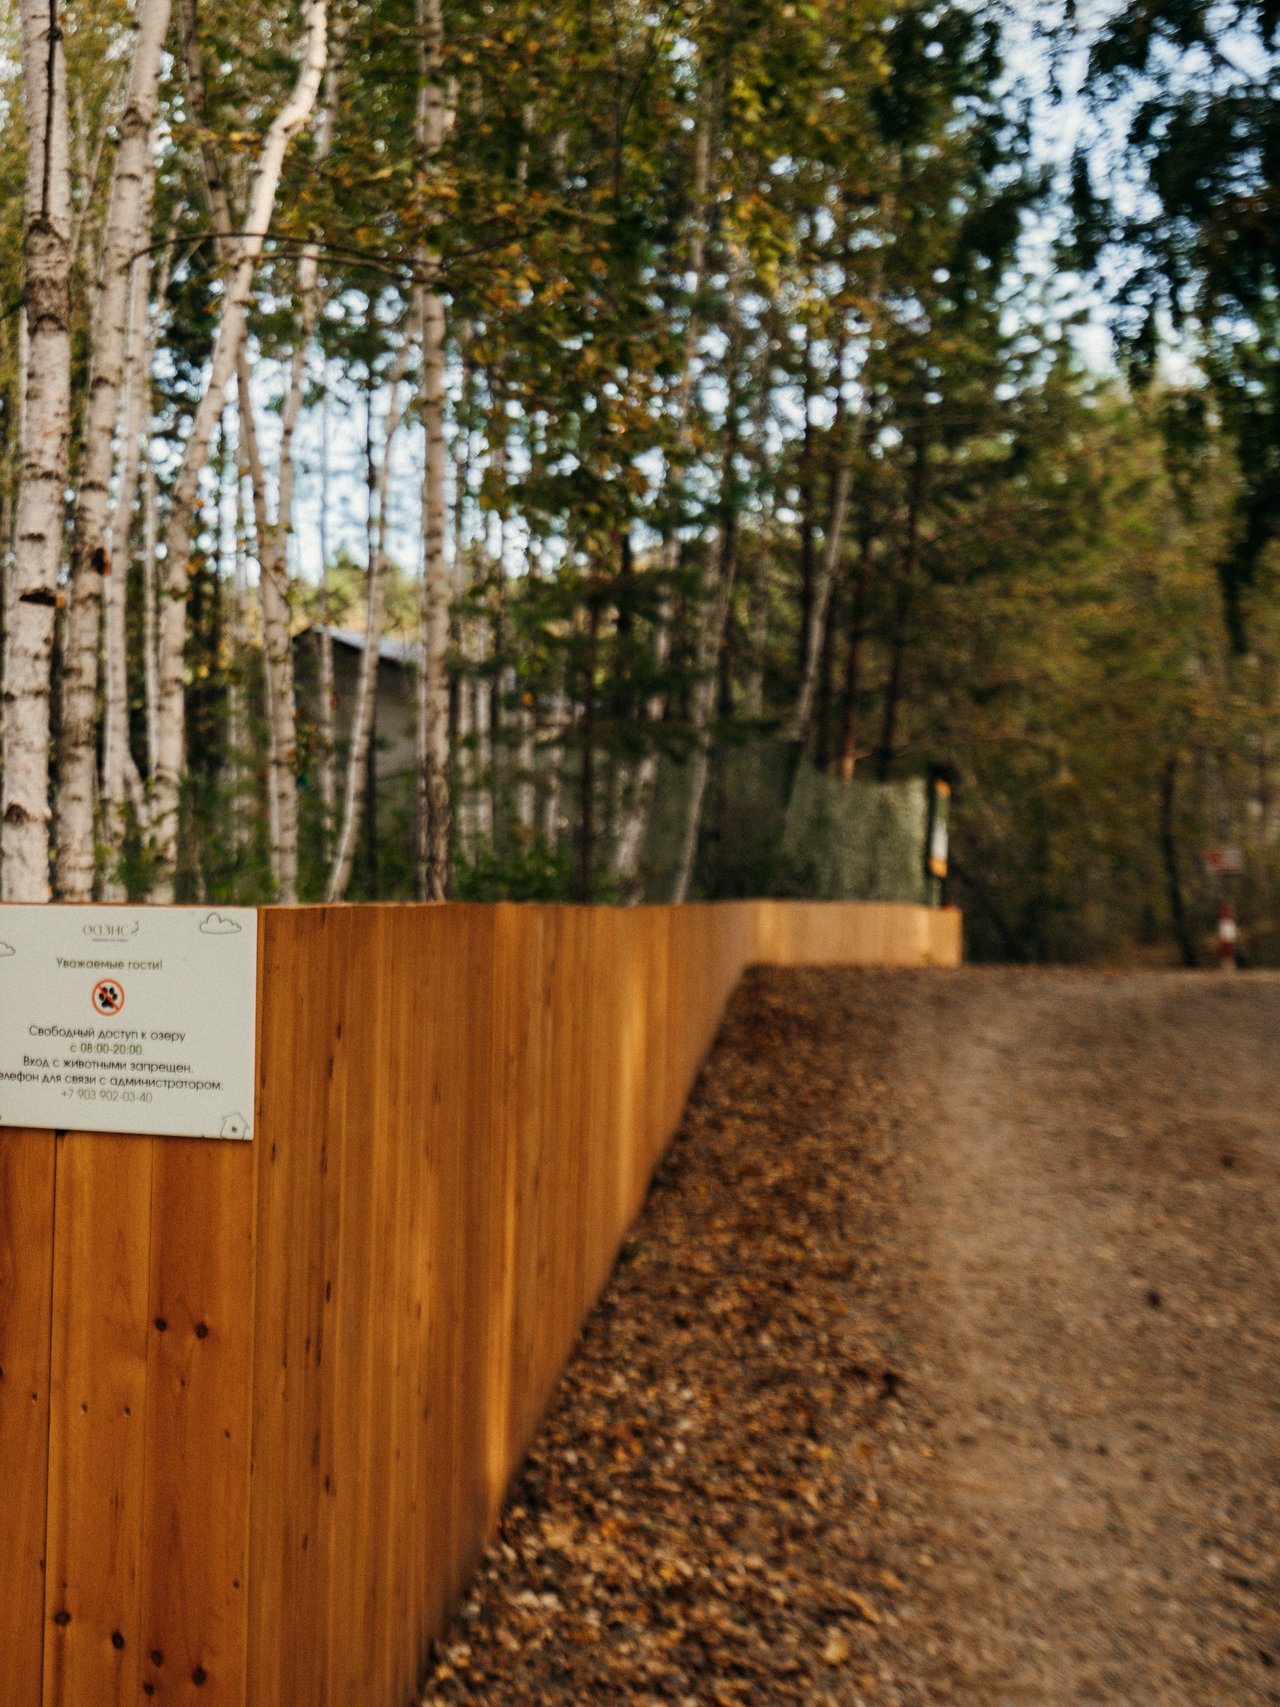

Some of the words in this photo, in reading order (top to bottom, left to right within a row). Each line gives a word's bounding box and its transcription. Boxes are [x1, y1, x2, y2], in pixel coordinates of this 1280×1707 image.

[56, 957, 125, 972] Уважаемые
[127, 959, 163, 972] гости!
[29, 1025, 95, 1040] Свободный
[98, 1029, 139, 1042] доступ
[141, 1031, 148, 1041] к
[150, 1031, 186, 1043] озеру
[70, 1044, 77, 1053] с
[23, 1056, 50, 1069] Вход
[53, 1059, 60, 1068] с
[63, 1058, 127, 1071] животными
[130, 1061, 194, 1074] запрещен.
[42, 1074, 62, 1085] для
[64, 1074, 97, 1086] связи
[99, 1077, 107, 1086] с
[110, 1077, 224, 1092] администратором:
[61, 1088, 75, 1100] +7
[77, 1089, 97, 1101] 903
